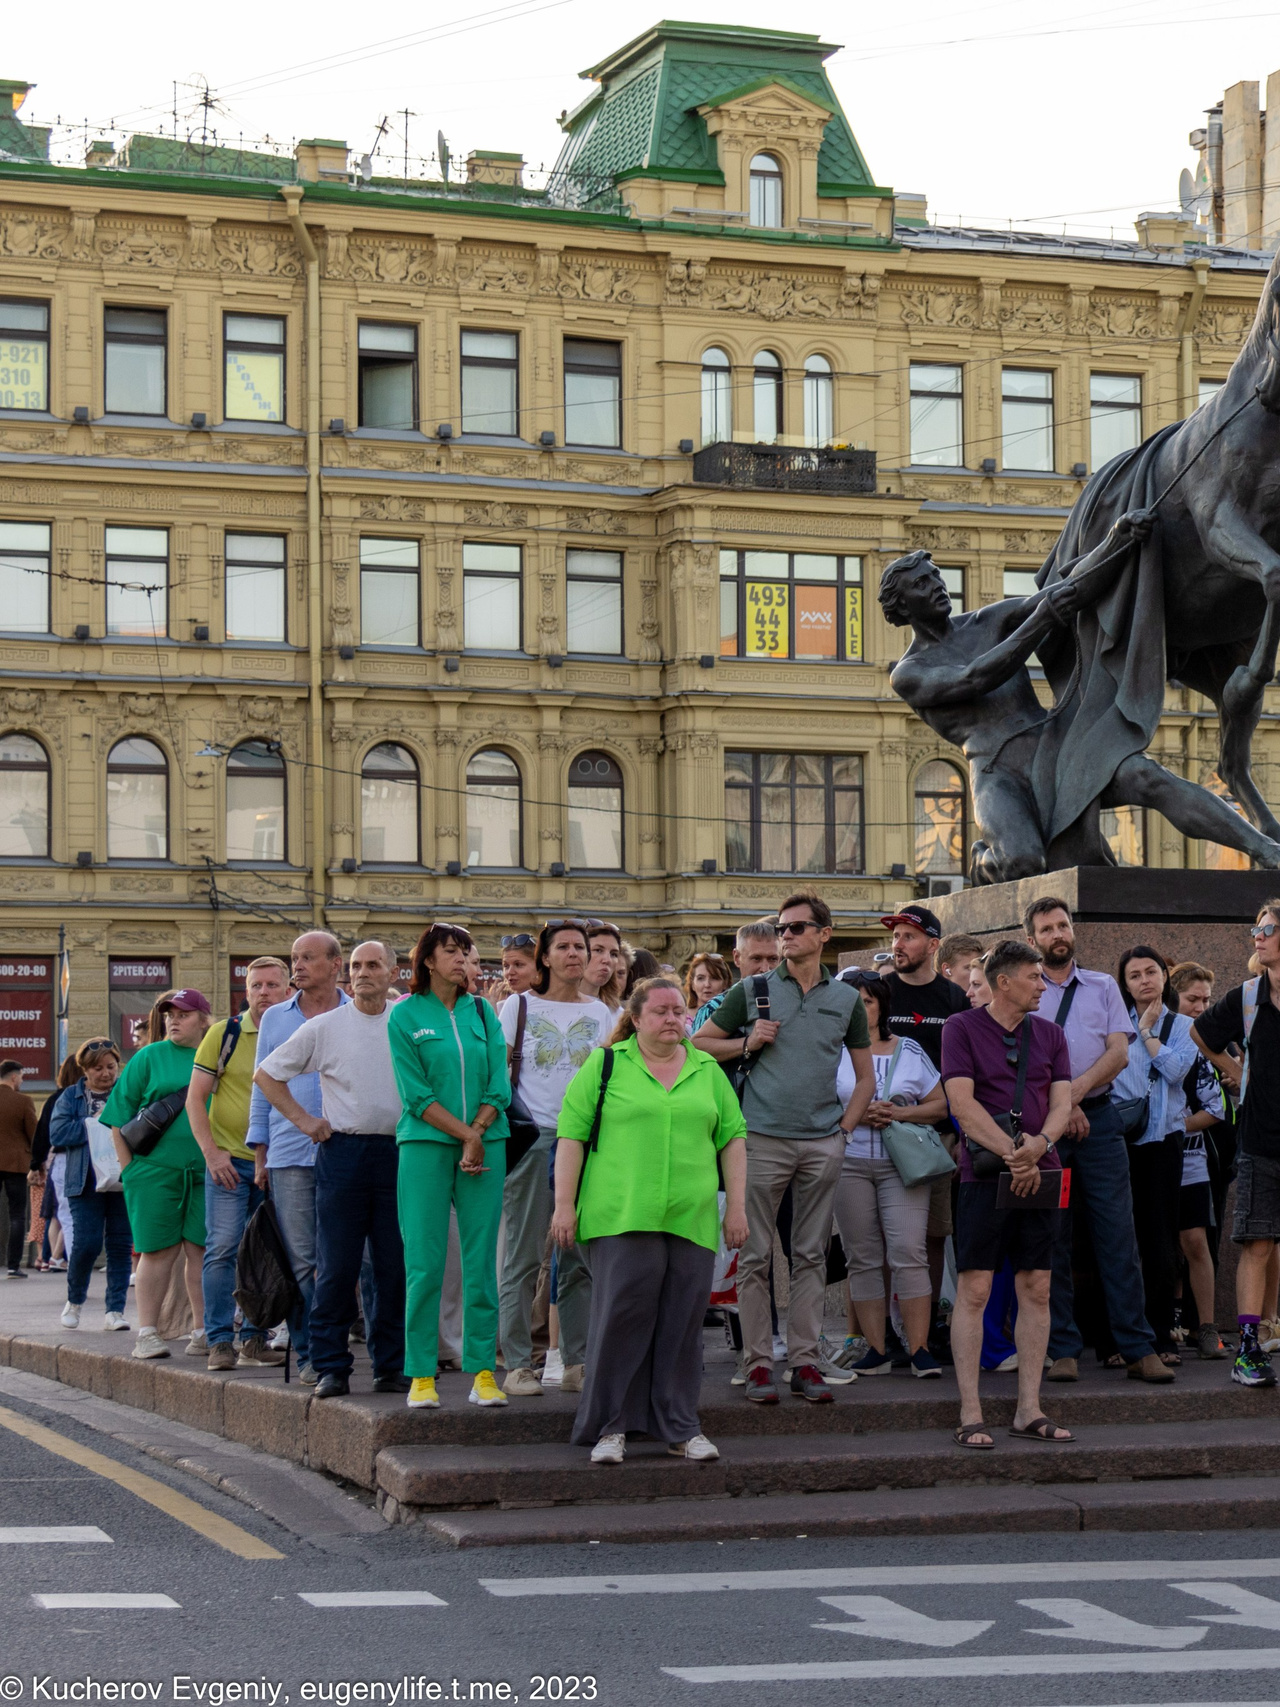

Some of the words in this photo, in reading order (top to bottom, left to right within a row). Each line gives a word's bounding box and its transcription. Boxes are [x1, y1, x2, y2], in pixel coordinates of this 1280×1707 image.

[0, 345, 39, 364] -921
[0, 367, 31, 386] 310
[0, 390, 41, 409] 0-13
[749, 585, 786, 607] 493
[755, 608, 780, 629] 44
[849, 590, 859, 655] SALE
[755, 630, 780, 651] 33
[113, 965, 167, 977] 2PITER.COM
